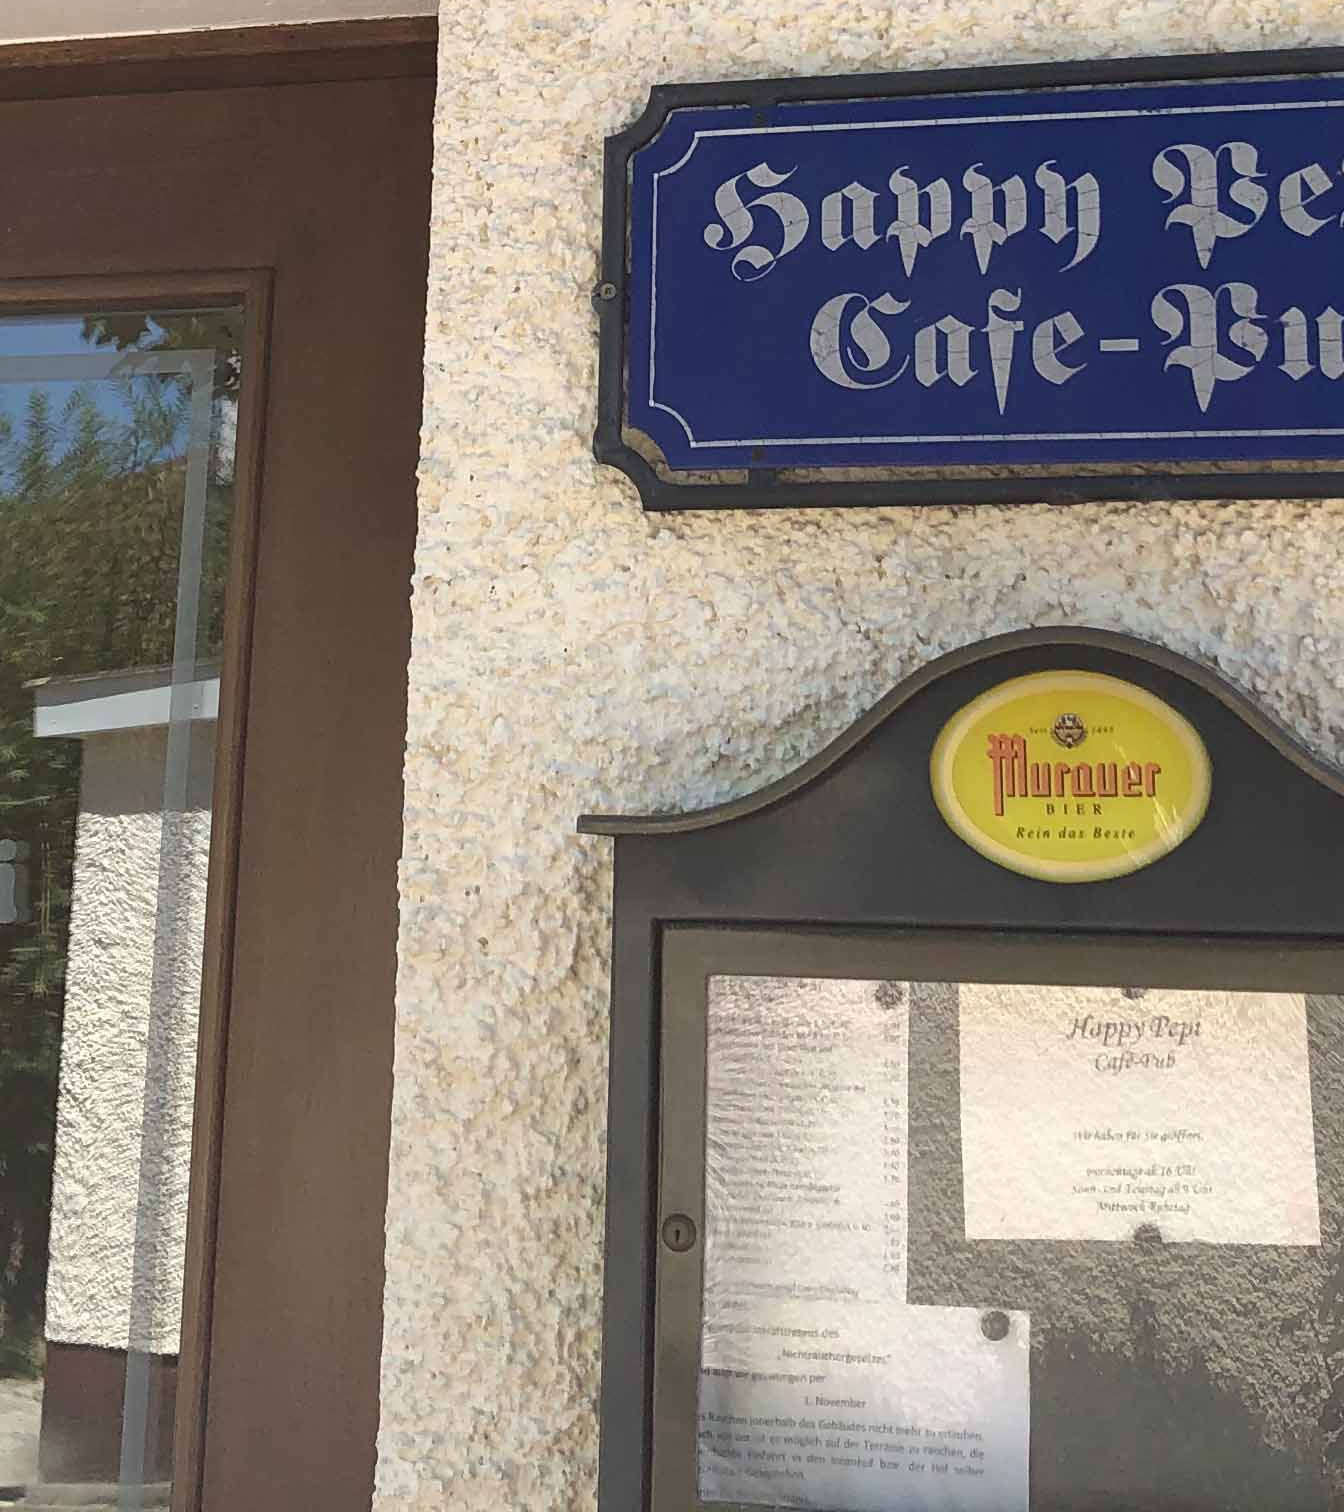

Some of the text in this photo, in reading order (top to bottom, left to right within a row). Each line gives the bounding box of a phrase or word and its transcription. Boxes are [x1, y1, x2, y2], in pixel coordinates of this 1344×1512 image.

[703, 159, 1100, 281] Happy
[987, 733, 1162, 817] Murauer
[1047, 804, 1103, 816] BIER
[1016, 827, 1137, 839] Rein das Beste
[1066, 1014, 1145, 1047] Happy
[816, 1395, 867, 1409] November
